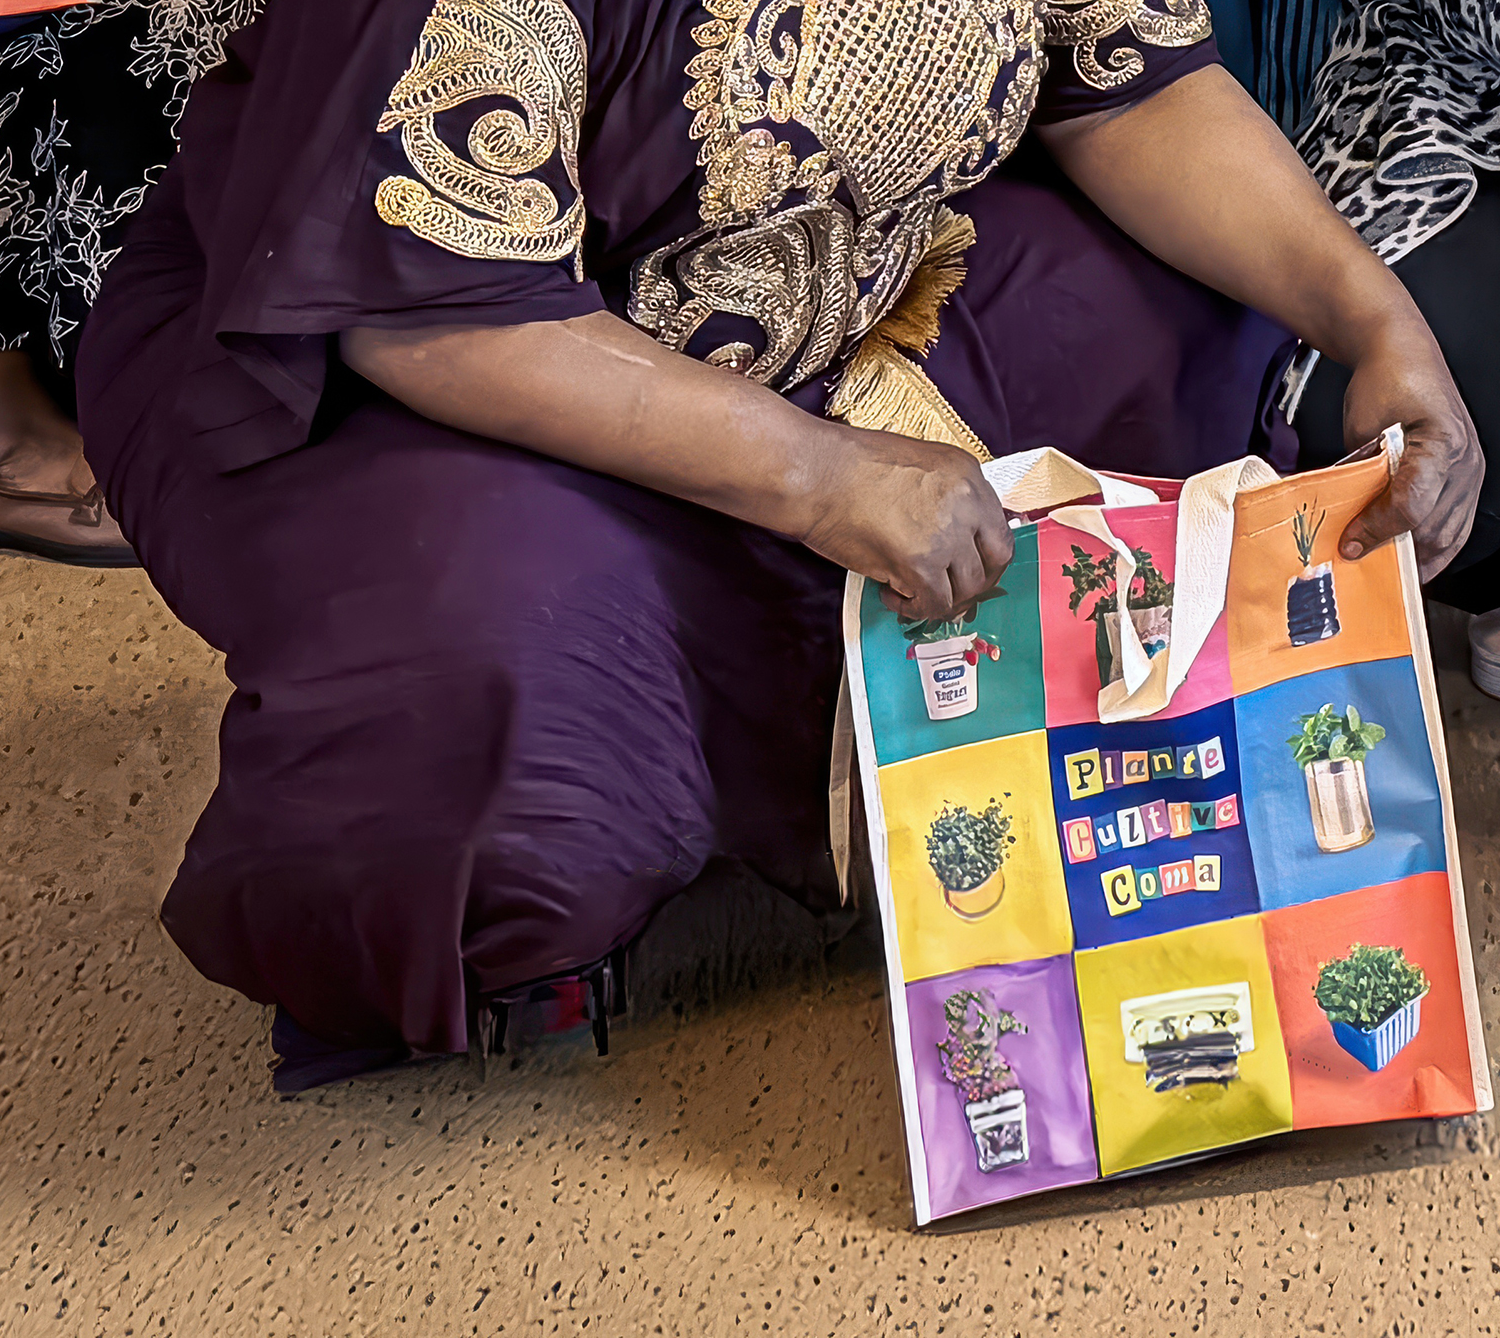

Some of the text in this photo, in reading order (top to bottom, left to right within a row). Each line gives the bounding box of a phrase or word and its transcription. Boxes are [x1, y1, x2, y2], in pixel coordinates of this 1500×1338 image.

[1072, 748, 1219, 790] Plante
[1069, 802, 1233, 858] Cultive
[1111, 863, 1215, 906] Coma
